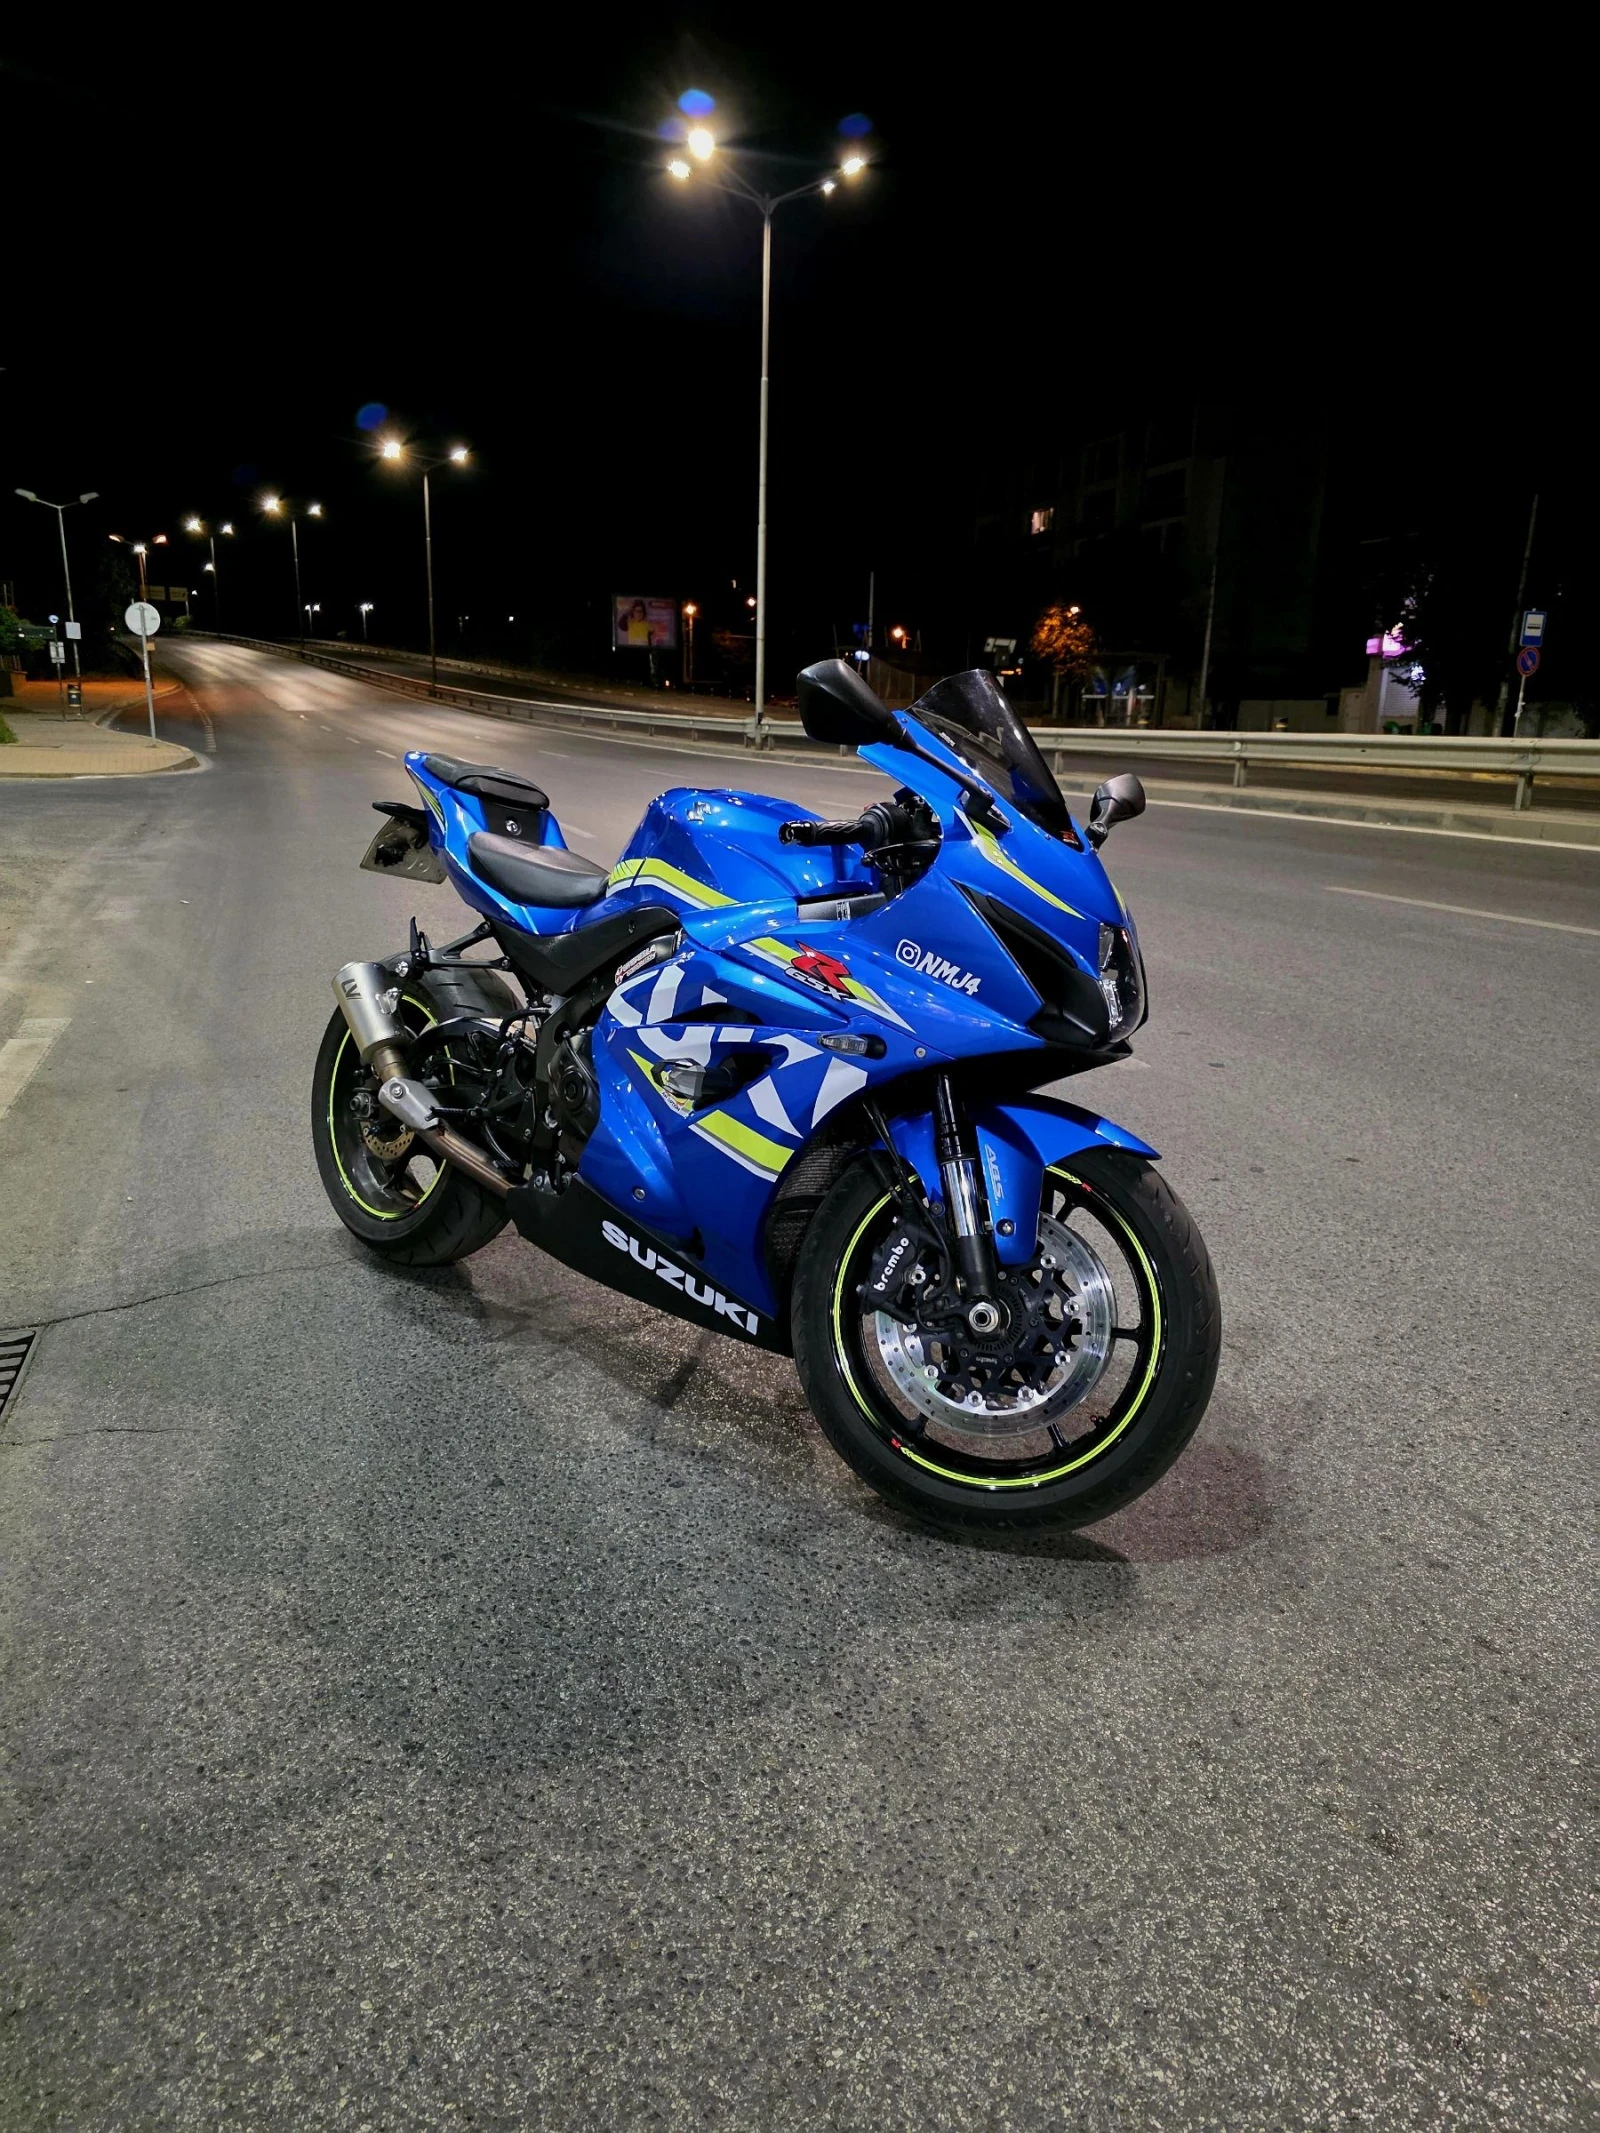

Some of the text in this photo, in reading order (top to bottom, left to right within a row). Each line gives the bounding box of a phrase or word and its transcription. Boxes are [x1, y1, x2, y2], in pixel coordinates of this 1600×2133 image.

[784, 967, 849, 1001] GSX
[915, 951, 981, 995] NMJ4
[984, 1144, 1005, 1201] ABS
[602, 1220, 758, 1335] SUZUKI
[873, 1237, 909, 1291] brembo
